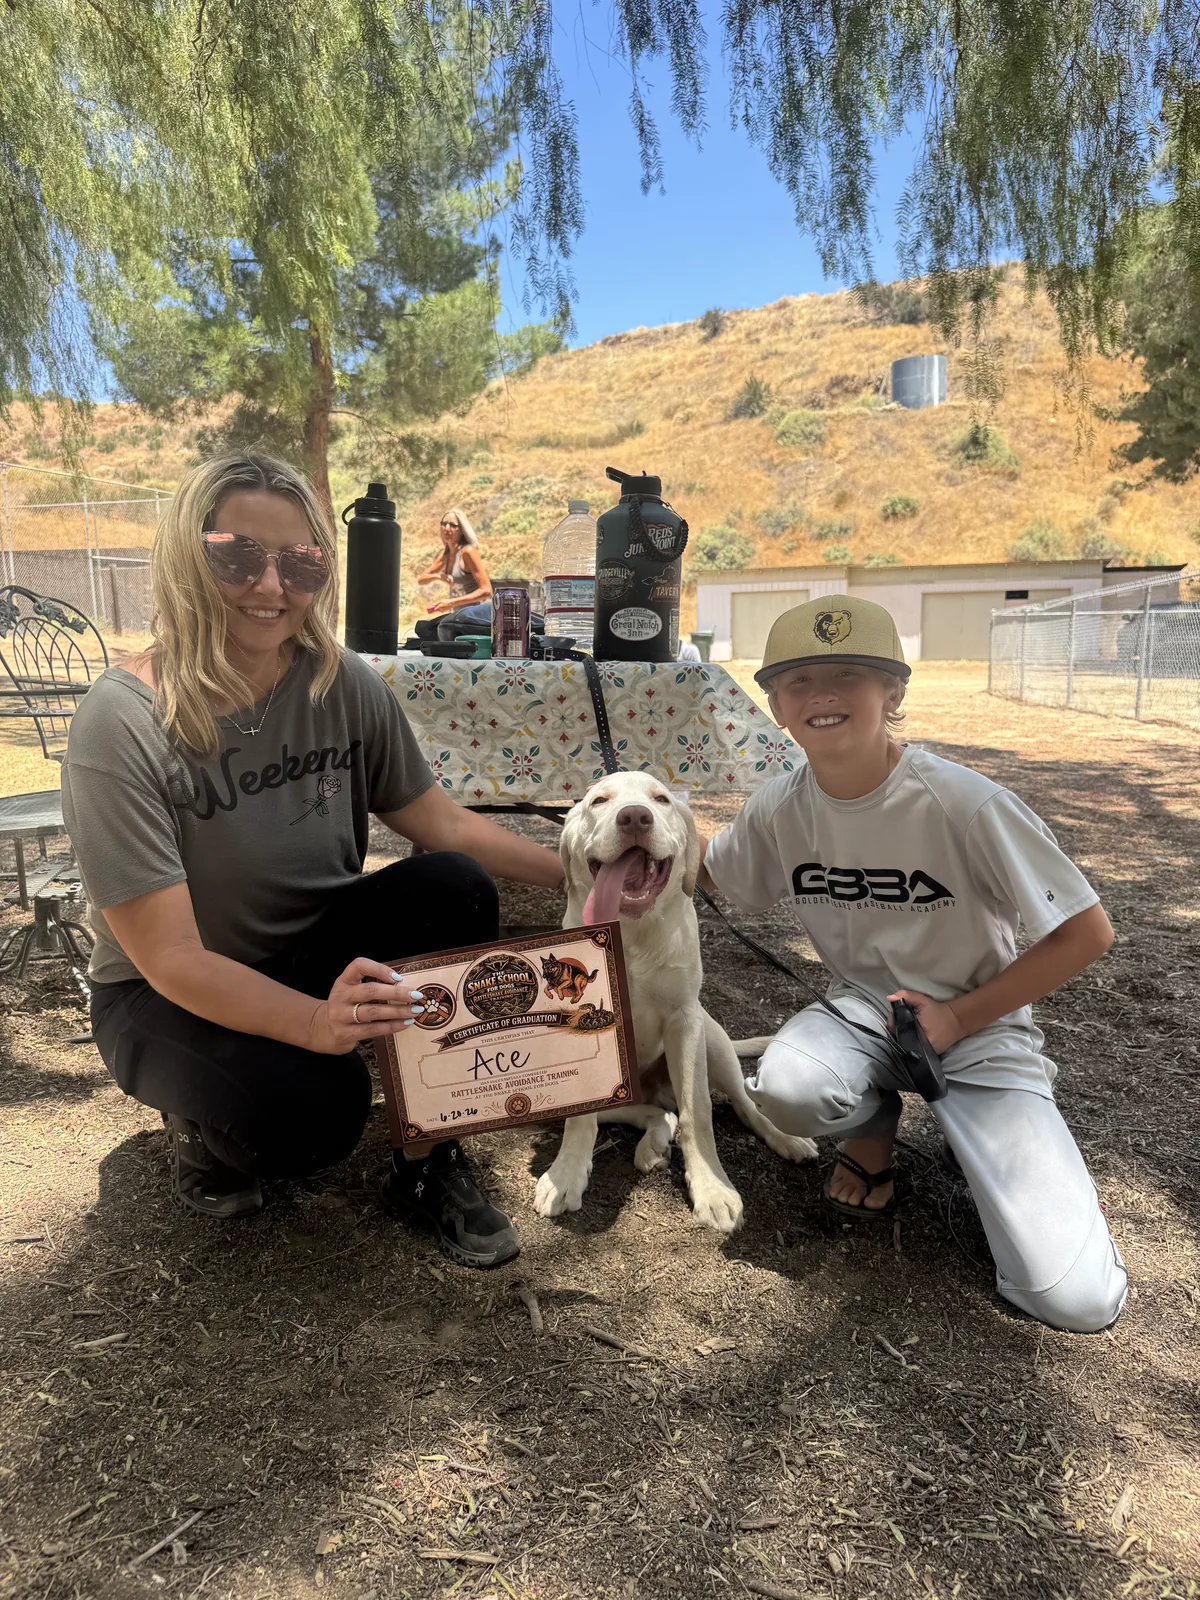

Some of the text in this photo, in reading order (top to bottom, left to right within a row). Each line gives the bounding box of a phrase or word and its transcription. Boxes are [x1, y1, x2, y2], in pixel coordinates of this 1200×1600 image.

[648, 526, 673, 544] RED'S
[612, 618, 659, 633] Great Notch
[627, 629, 643, 637] Inn
[792, 863, 956, 904] GBBA
[856, 900, 904, 911] BASEBALL
[910, 900, 956, 912] ACADEMY
[467, 972, 533, 994] SNAKE SCHOOL
[487, 985, 498, 993] FOR
[453, 1013, 558, 1039] CERTIFICATE OF GRADUATION
[494, 1033, 520, 1042] CERTIFIES
[467, 1048, 531, 1080] Ace
[451, 1068, 579, 1098] RATTLESNAKE AVOIDANCE TRAINING
[494, 1089, 511, 1097] SNAKE
